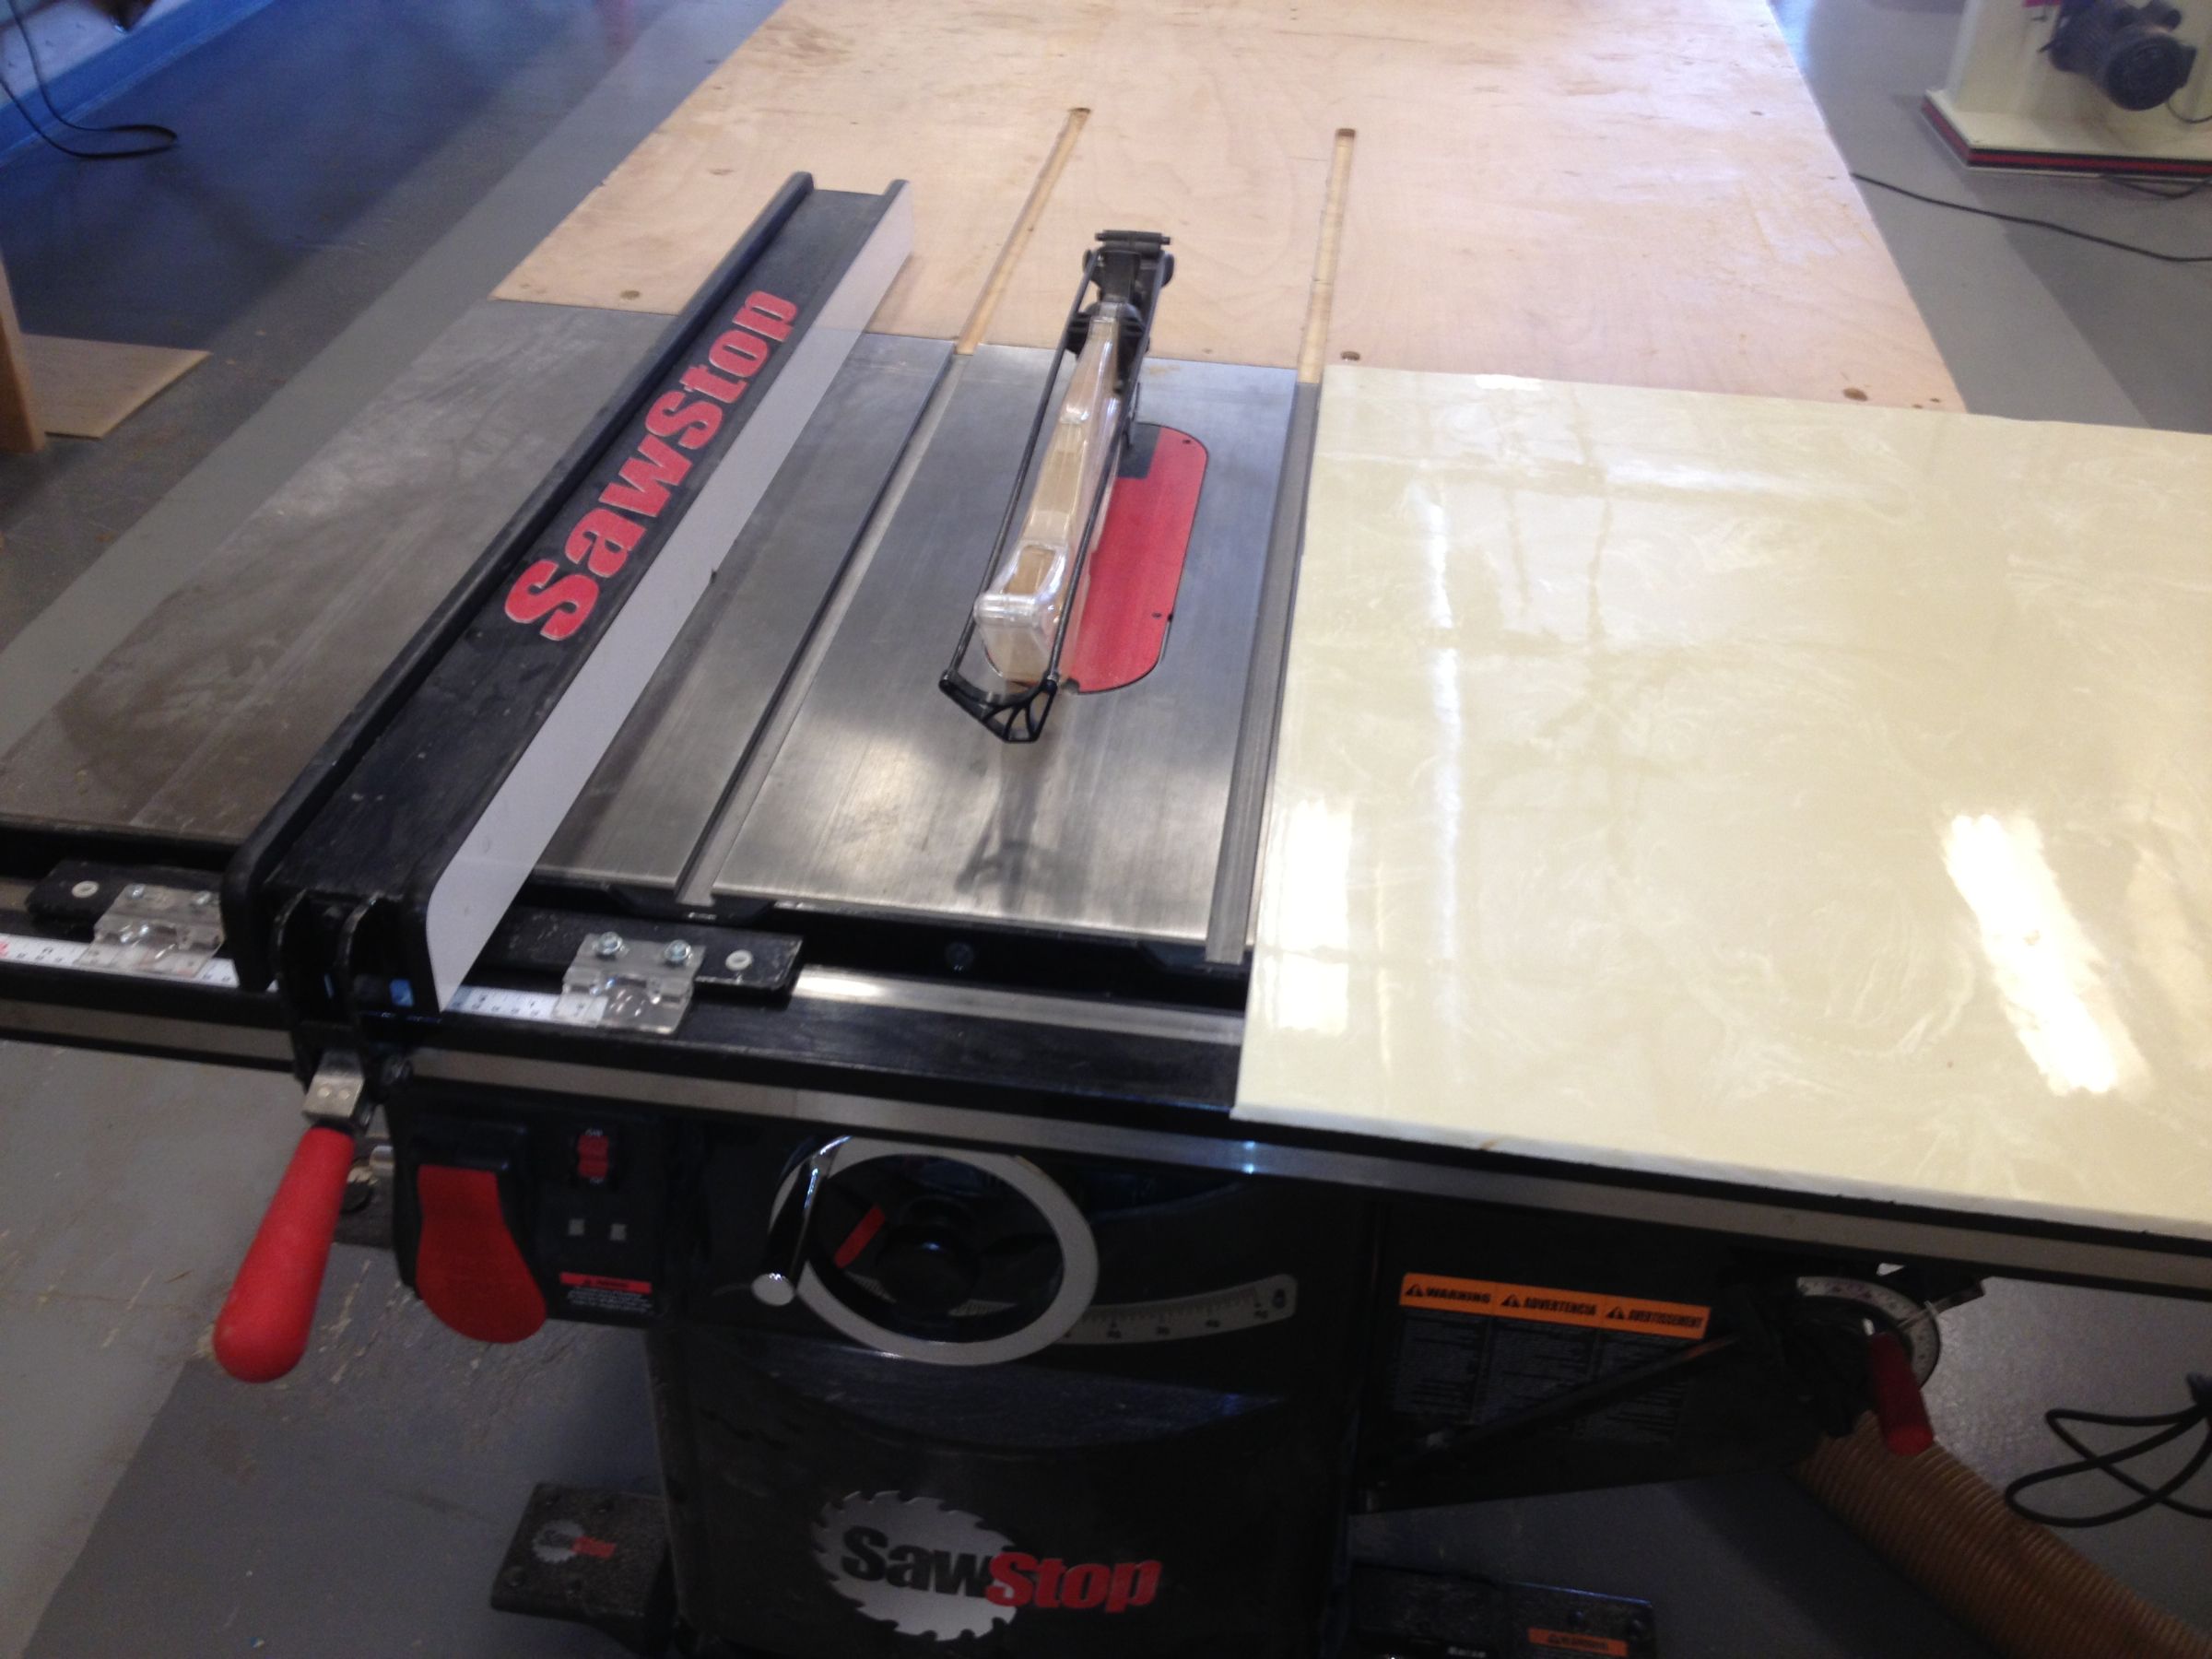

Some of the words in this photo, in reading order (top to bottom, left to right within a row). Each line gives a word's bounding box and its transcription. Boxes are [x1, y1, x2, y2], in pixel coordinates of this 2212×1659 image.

[504, 290, 797, 641] SawStop
[1426, 1287, 1491, 1304] WARNING
[841, 1526, 1162, 1613] SawStop
